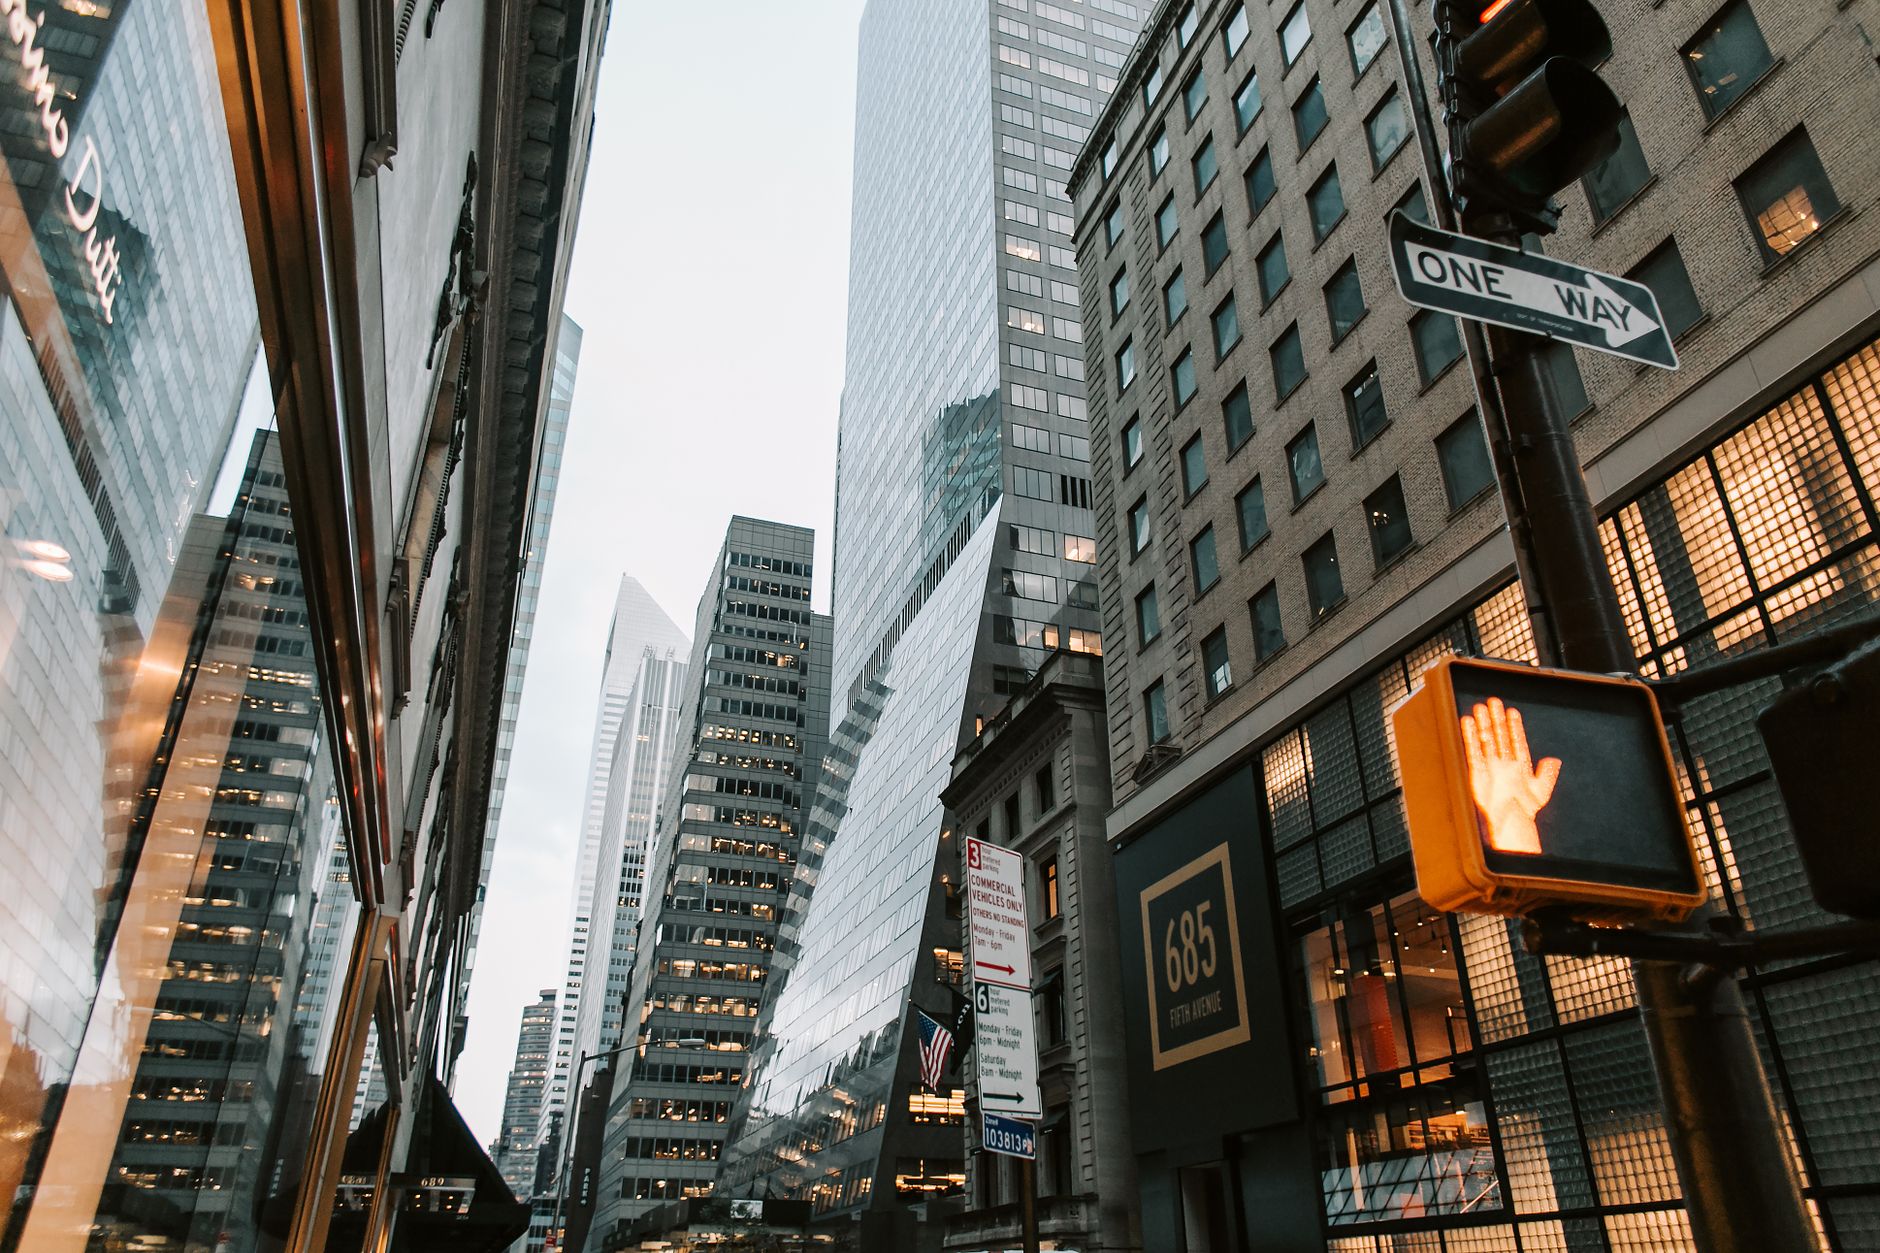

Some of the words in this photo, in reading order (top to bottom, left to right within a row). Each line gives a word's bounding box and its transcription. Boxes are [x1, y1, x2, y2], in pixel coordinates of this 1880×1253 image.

[66, 134, 120, 325] Dutti
[1417, 250, 1512, 300] ONE
[1553, 283, 1631, 332] WAY
[970, 843, 980, 867] 3
[982, 855, 1001, 867] metered
[983, 864, 999, 874] parking
[971, 874, 1016, 897] COMMERCIAL
[972, 889, 1005, 908] VEHICLES
[1007, 899, 1023, 913] ONLY
[973, 907, 993, 920] OTHERS
[993, 913, 1001, 922] NO
[1001, 914, 1025, 928] STANDING
[974, 923, 995, 937] Monday
[999, 930, 1016, 943] Friday
[974, 936, 986, 947] 7am
[991, 940, 1003, 951] 6pm
[1165, 900, 1217, 993] 685
[977, 985, 988, 1012] 6
[990, 986, 1001, 996] hour
[991, 996, 1011, 1007] metered
[991, 1005, 1009, 1016] parking
[1169, 1002, 1191, 1029] FIFTH
[1192, 990, 1223, 1020] AVENUE
[978, 1021, 1001, 1036] Monday
[1005, 1026, 1022, 1039] Friday
[979, 1035, 993, 1047] 6pm
[997, 1037, 1021, 1050] Midnight
[980, 1053, 1007, 1067] Saturday
[981, 1067, 994, 1077] 8am
[998, 1068, 1022, 1082] Midnight
[985, 1127, 1022, 1152] 103813
[421, 1177, 445, 1187] 689
